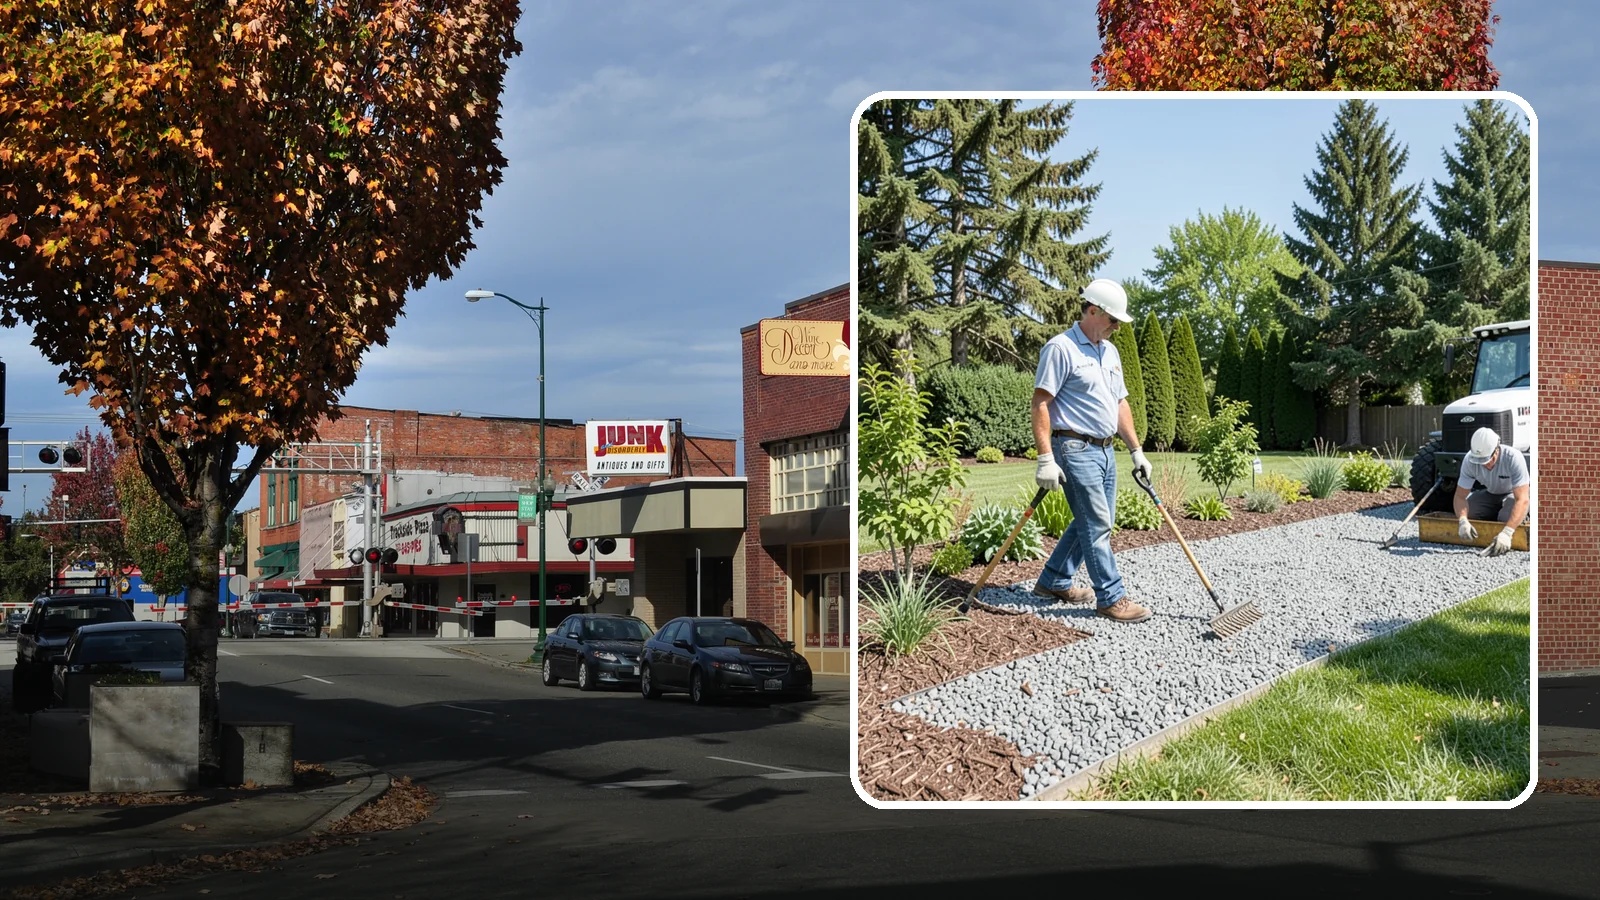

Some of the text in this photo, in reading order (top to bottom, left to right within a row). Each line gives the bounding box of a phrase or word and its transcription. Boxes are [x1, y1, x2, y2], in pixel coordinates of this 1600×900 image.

[595, 425, 664, 457] JUNK
[607, 446, 646, 454] DISORDERLY
[597, 460, 665, 470] ANTIQUES AND GIFTS
[390, 520, 429, 539] Trackside Pizza
